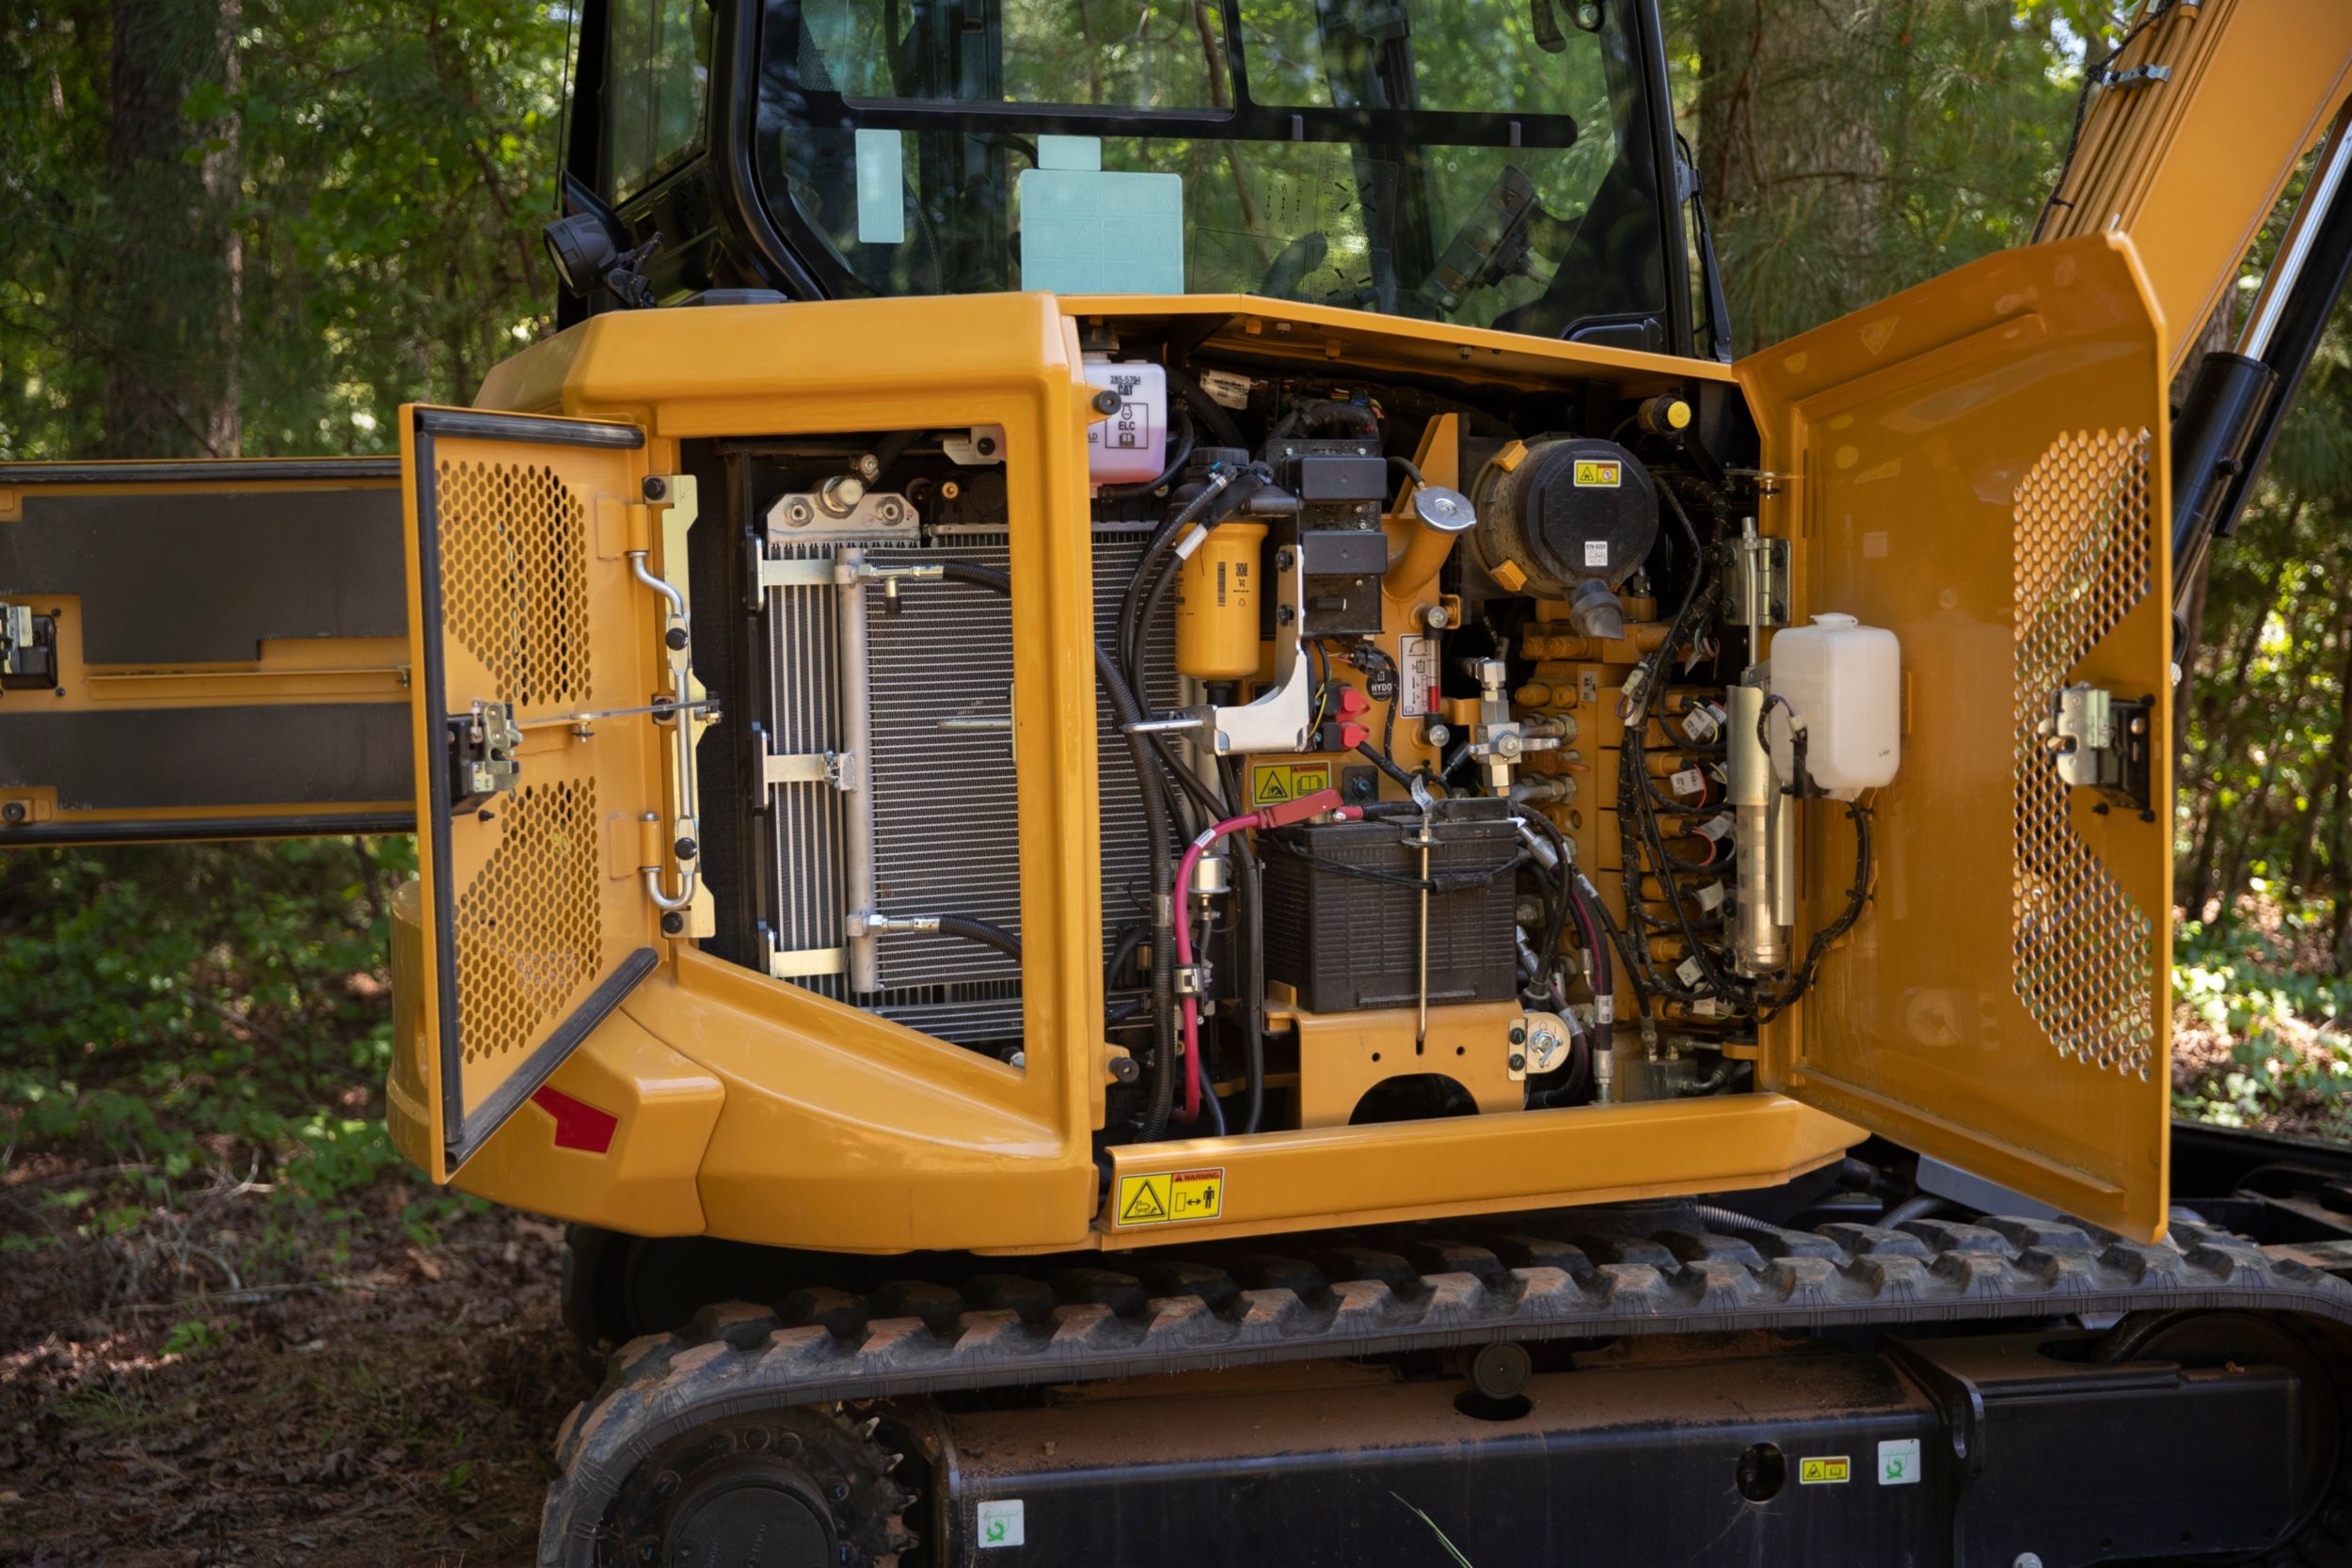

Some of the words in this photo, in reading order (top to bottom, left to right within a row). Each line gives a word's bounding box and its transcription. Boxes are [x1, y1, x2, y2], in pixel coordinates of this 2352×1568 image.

[1118, 385, 1133, 395] CAT
[1119, 421, 1136, 431] ELC
[1184, 1172, 1220, 1181] WARNING
